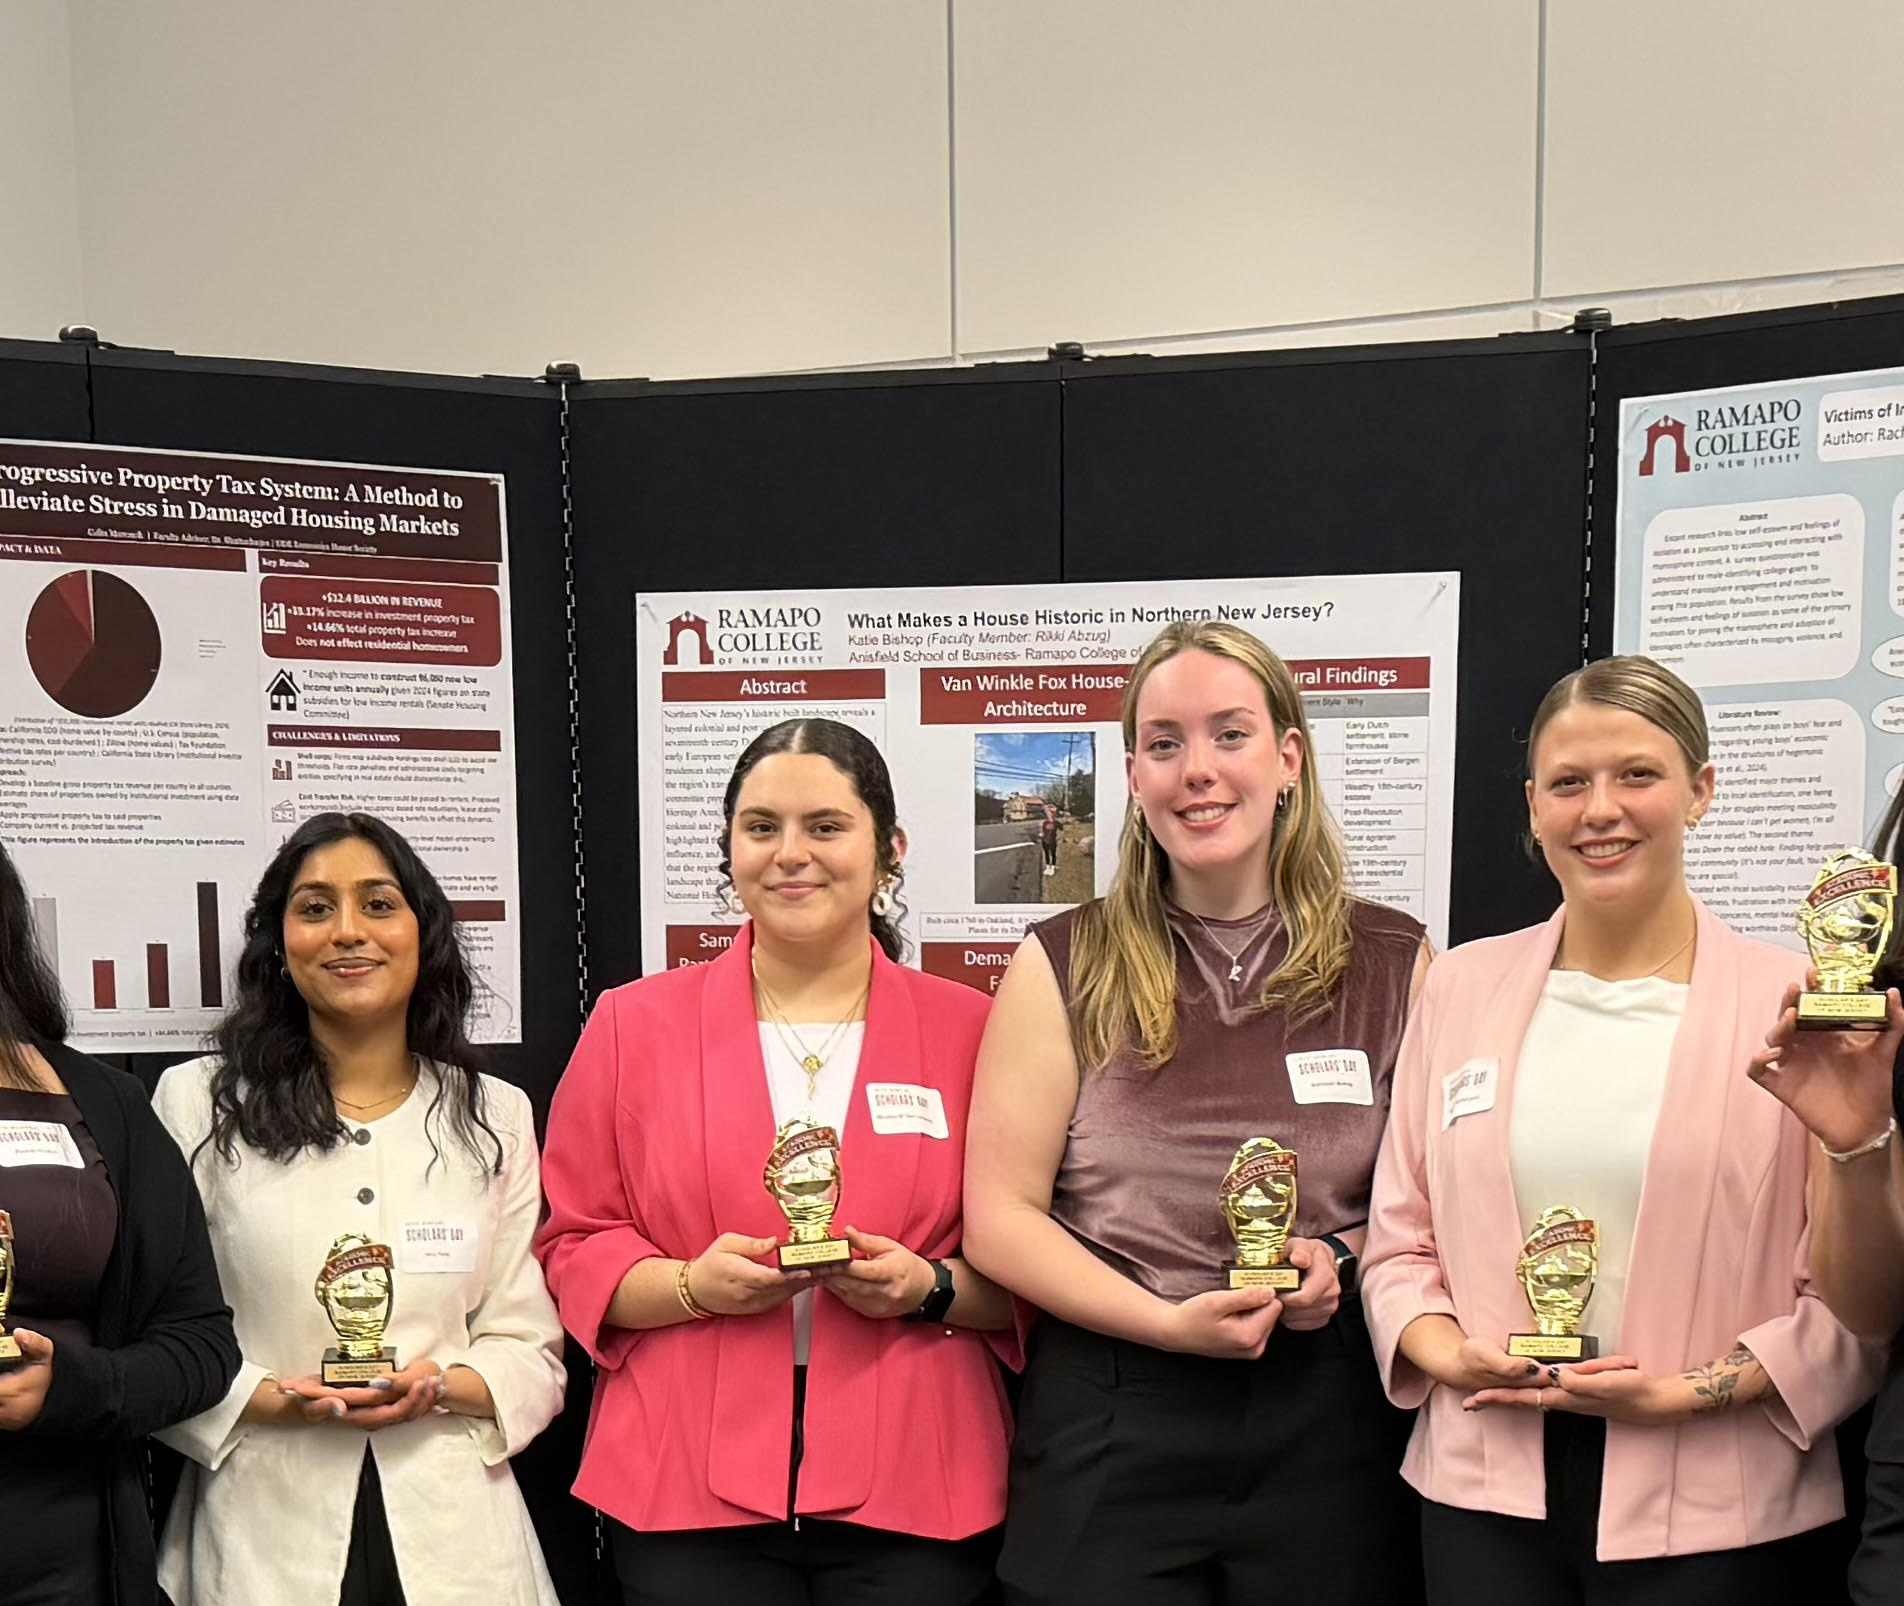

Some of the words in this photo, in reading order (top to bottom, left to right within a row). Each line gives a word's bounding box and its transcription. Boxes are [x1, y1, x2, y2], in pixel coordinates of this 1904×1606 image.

[1696, 399, 1801, 432] RAMAPO
[1824, 407, 1873, 424] Victims
[1878, 405, 1892, 419] of
[1695, 427, 1801, 457] COLLEGE
[1823, 430, 1873, 447] Author:
[1695, 462, 1710, 471] OF
[1717, 459, 1746, 469] NEW
[1753, 453, 1801, 468] JERSEY
[117, 467, 213, 496] Property
[215, 474, 256, 495] Tax
[259, 477, 341, 502] System:
[345, 483, 361, 501] A
[364, 484, 441, 509] Method
[443, 490, 464, 510] to
[89, 494, 158, 518] Stress
[162, 498, 185, 520] in
[188, 501, 286, 529] Damaged
[290, 507, 377, 536] Housing
[378, 514, 460, 537] Markets
[717, 607, 822, 629] RAMAPO
[847, 612, 892, 630] What
[897, 611, 953, 629] Makes
[958, 615, 968, 627] a
[973, 610, 1030, 627] House
[1034, 608, 1104, 627] Historic
[1109, 608, 1126, 624] in
[1131, 604, 1211, 624] Northern
[1216, 604, 1257, 620] New
[1261, 601, 1335, 622] Jersey?
[718, 632, 823, 653] COLLEGE
[847, 633, 879, 647] Katie
[882, 632, 923, 648] Bishop
[926, 632, 975, 647] (Faculty
[978, 631, 1032, 645] Member:
[1067, 629, 1112, 644] Abzug)
[718, 656, 733, 665] OF
[742, 656, 770, 665] NEW
[777, 655, 824, 665] JERSEY
[903, 649, 944, 663] School
[947, 648, 959, 662] of
[1024, 646, 1077, 663] Ramapo
[1079, 645, 1127, 662] College
[1129, 645, 1143, 659] of
[940, 675, 972, 692] Van
[976, 674, 1034, 692] Winkle
[1038, 673, 1067, 690] Fox
[1071, 672, 1130, 690] House-
[1325, 665, 1398, 687] Findings
[739, 678, 808, 696] Abstract
[983, 699, 1088, 718] Architecture
